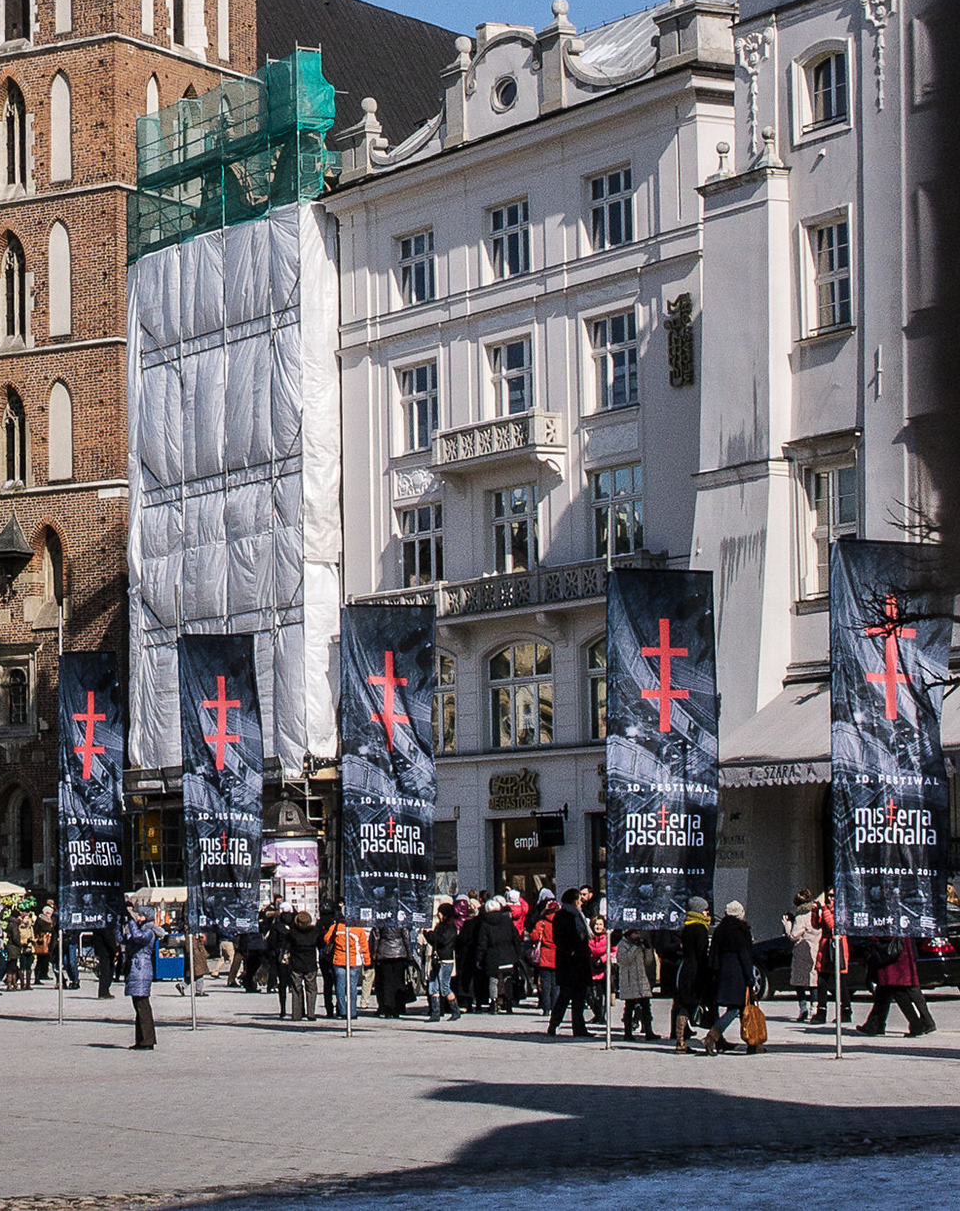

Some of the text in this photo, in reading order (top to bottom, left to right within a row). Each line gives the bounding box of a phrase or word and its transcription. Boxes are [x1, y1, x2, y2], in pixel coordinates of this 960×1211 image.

[763, 765, 796, 779] SZARA
[854, 774, 939, 786] 10. FESTIWAL
[627, 783, 709, 793] 10. FESTIWAL
[379, 796, 427, 807] FESTIWAL
[488, 796, 538, 809] MEGASTORE
[625, 825, 704, 853] paschalia
[855, 824, 937, 852] paschalia
[360, 835, 425, 860] paschalia
[69, 850, 122, 871] paschalia
[384, 871, 409, 879] MARCA
[652, 866, 685, 875] MARCA
[880, 866, 914, 875] MARCA
